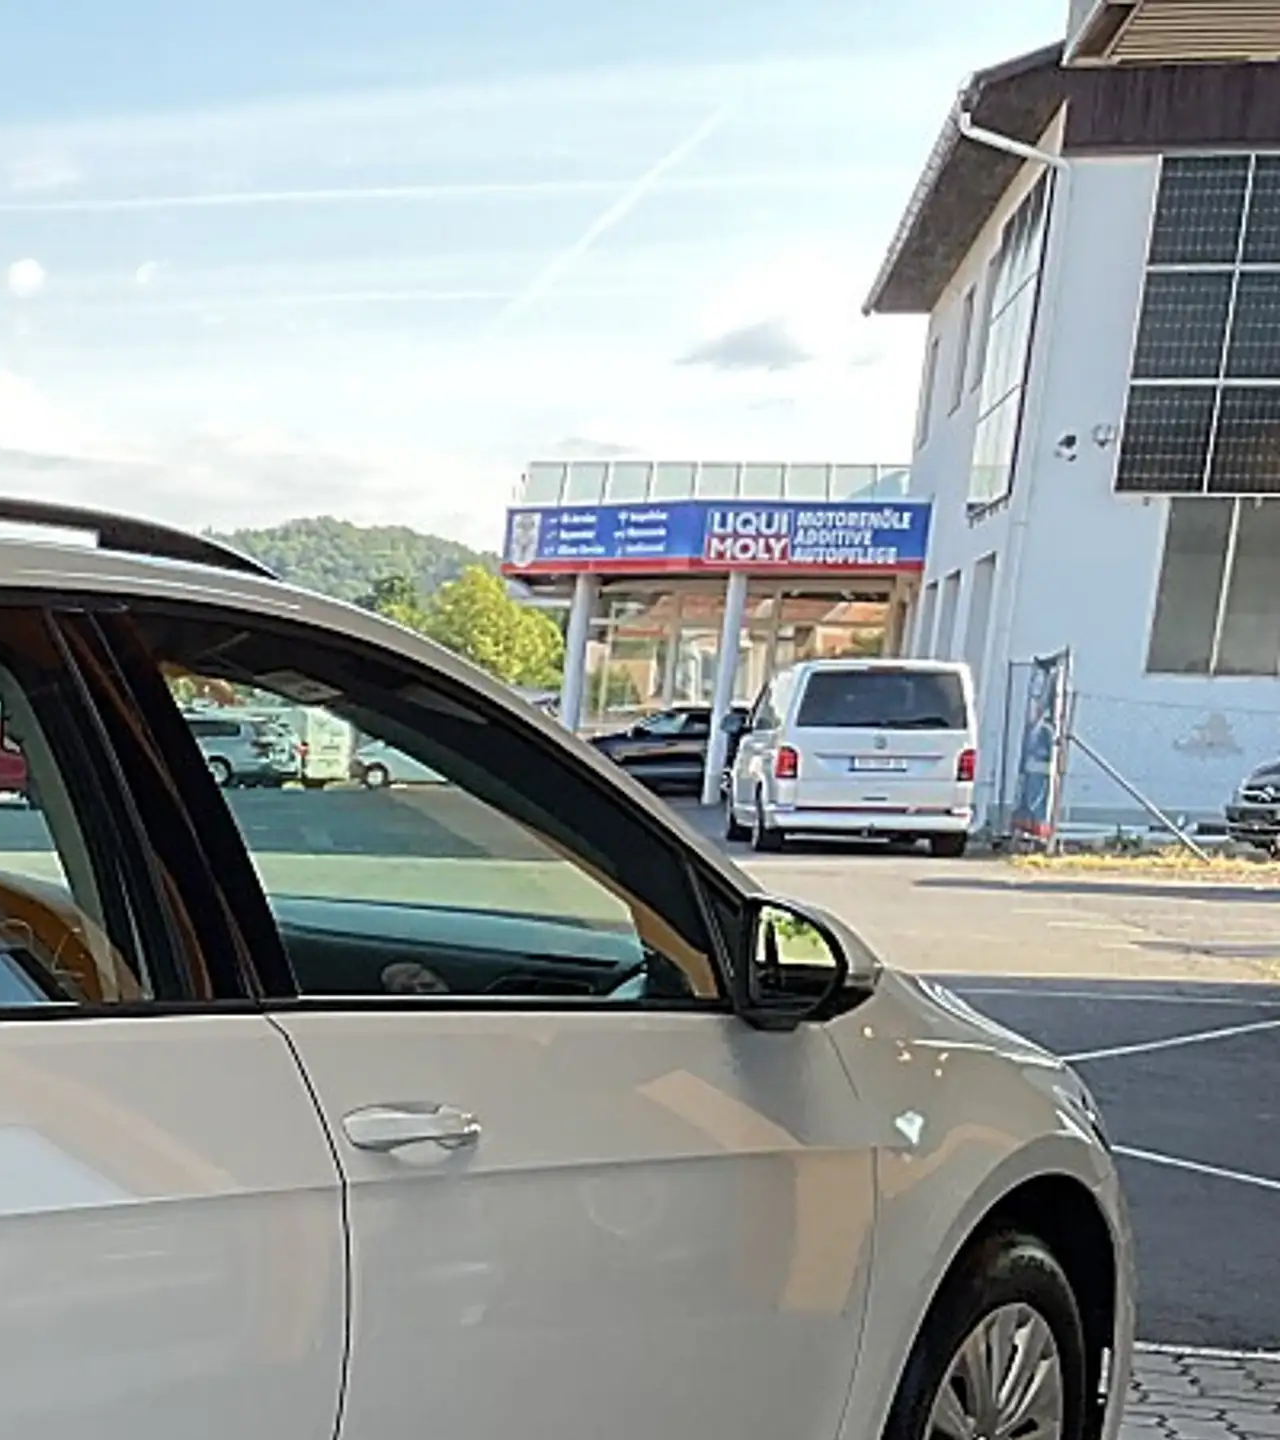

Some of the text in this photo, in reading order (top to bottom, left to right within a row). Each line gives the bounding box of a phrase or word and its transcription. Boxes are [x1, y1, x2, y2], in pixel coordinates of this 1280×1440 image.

[712, 511, 789, 536] LIQUI
[709, 537, 789, 562] MOLY
[793, 528, 874, 547] ADDITIVE
